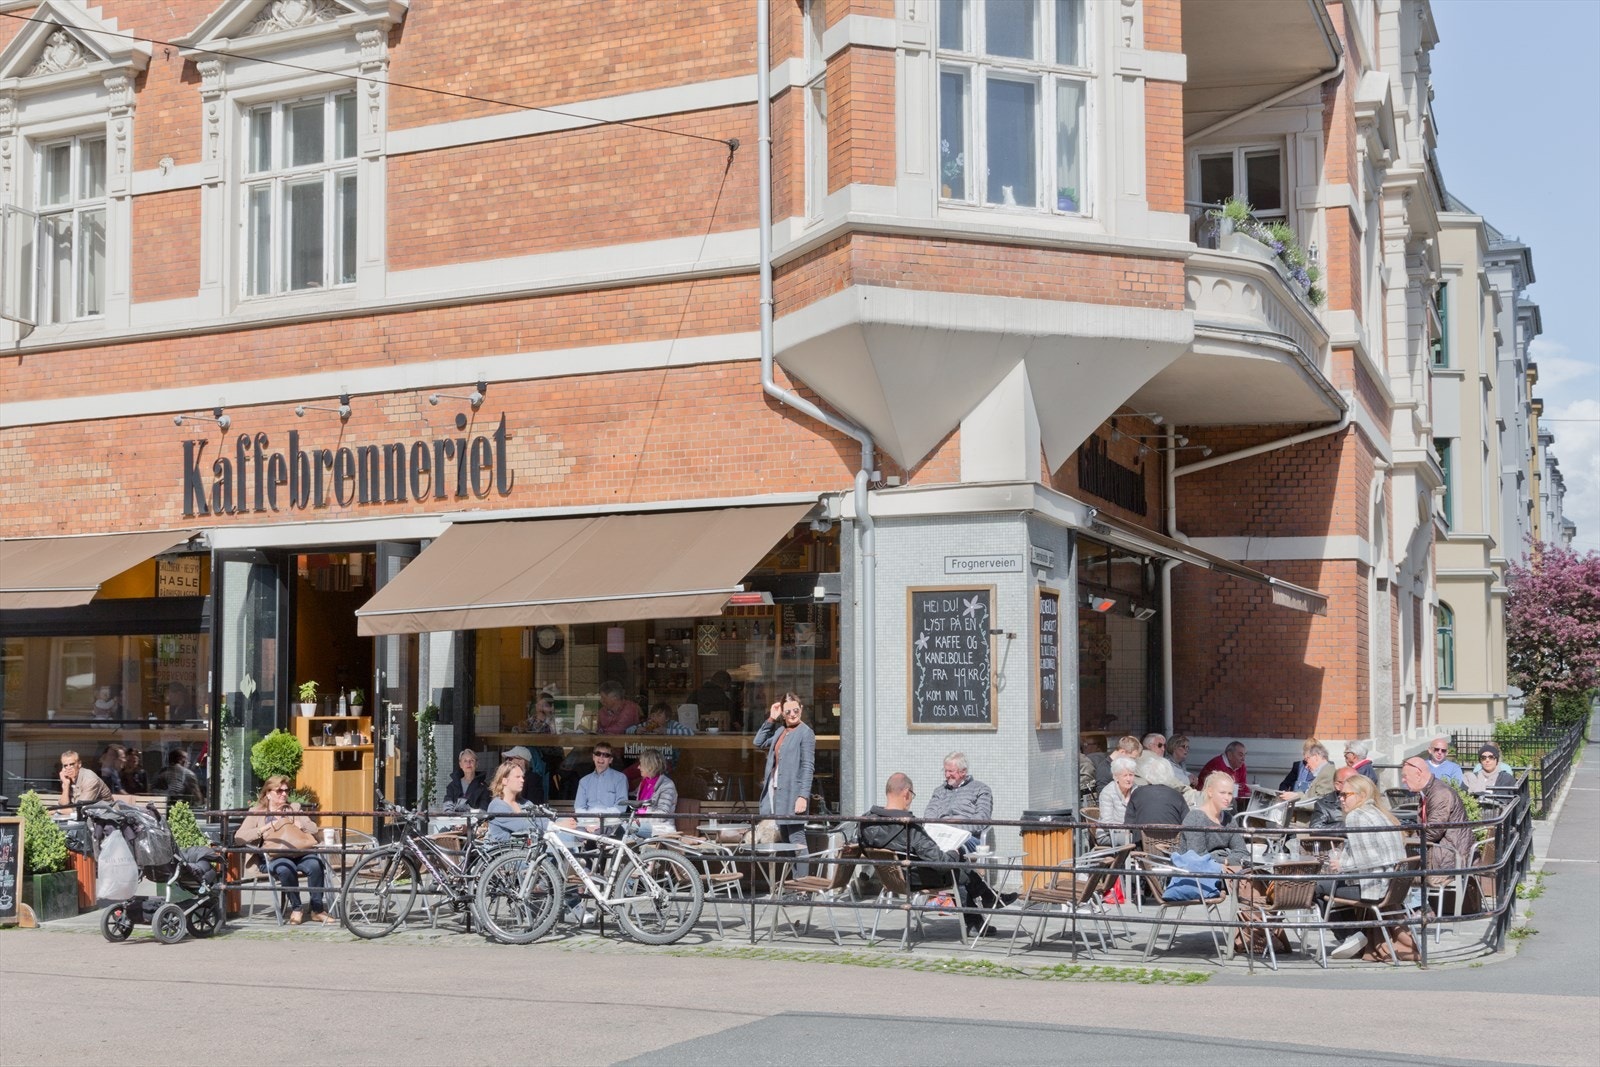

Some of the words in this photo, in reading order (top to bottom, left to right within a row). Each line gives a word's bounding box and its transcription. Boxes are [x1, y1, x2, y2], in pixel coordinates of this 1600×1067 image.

[181, 411, 515, 517] Kaffebrenneriet
[951, 557, 1016, 571] Frognerveien
[159, 575, 199, 588] HASLE
[923, 600, 939, 613] HEI
[942, 597, 960, 613] DU!
[923, 617, 946, 632] LYST
[950, 614, 962, 632] PÅ
[964, 617, 977, 631] EN
[935, 635, 961, 649] KAFFE
[966, 635, 978, 650] OG
[924, 651, 974, 665] KANELBOLLE
[932, 668, 948, 681] FRA
[953, 667, 967, 688] 49
[925, 689, 942, 702] KOM
[945, 690, 958, 701] INN
[963, 689, 976, 701] TIL
[933, 704, 947, 717] OSS
[948, 704, 960, 716] DA
[961, 703, 979, 718] VEL!
